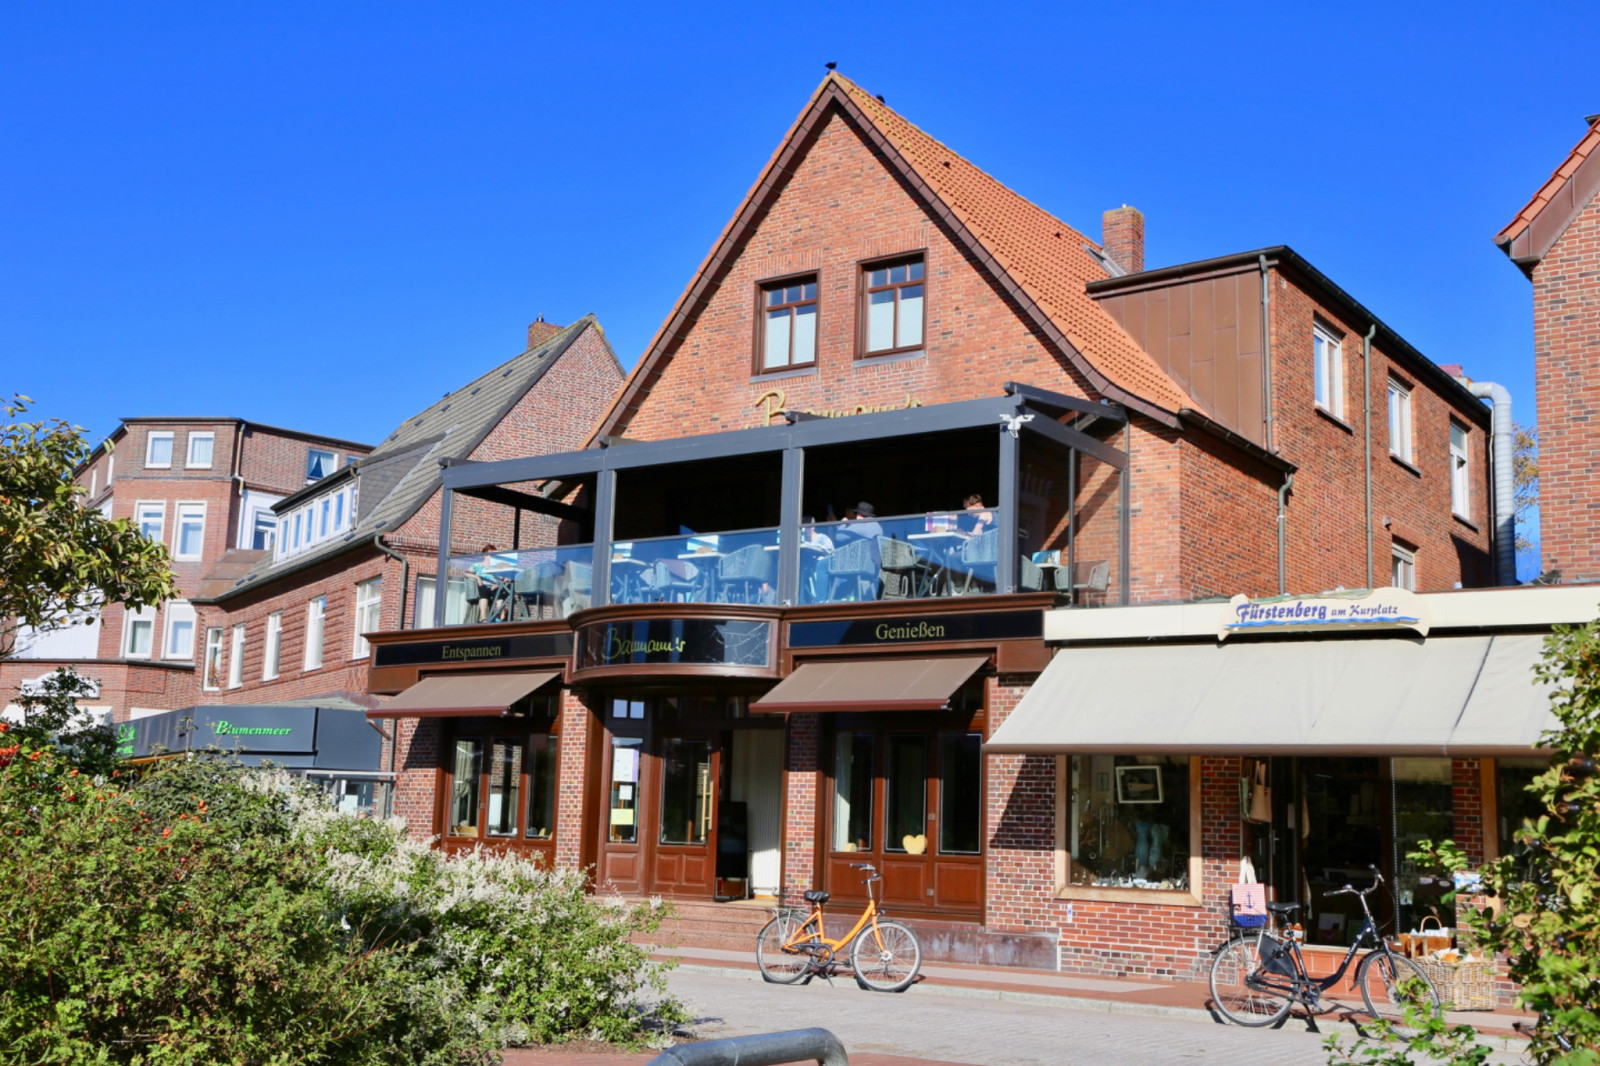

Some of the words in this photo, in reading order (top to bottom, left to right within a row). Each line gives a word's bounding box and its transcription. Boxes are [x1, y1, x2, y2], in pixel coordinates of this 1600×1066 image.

[1235, 601, 1327, 623] Fürstenberg
[1331, 608, 1346, 616] am
[1349, 603, 1398, 617] Kurplatz
[875, 621, 945, 640] Genießen
[601, 627, 686, 660] Baumann's
[442, 645, 502, 662] Entspannen
[215, 720, 292, 735] Blumenmeer
